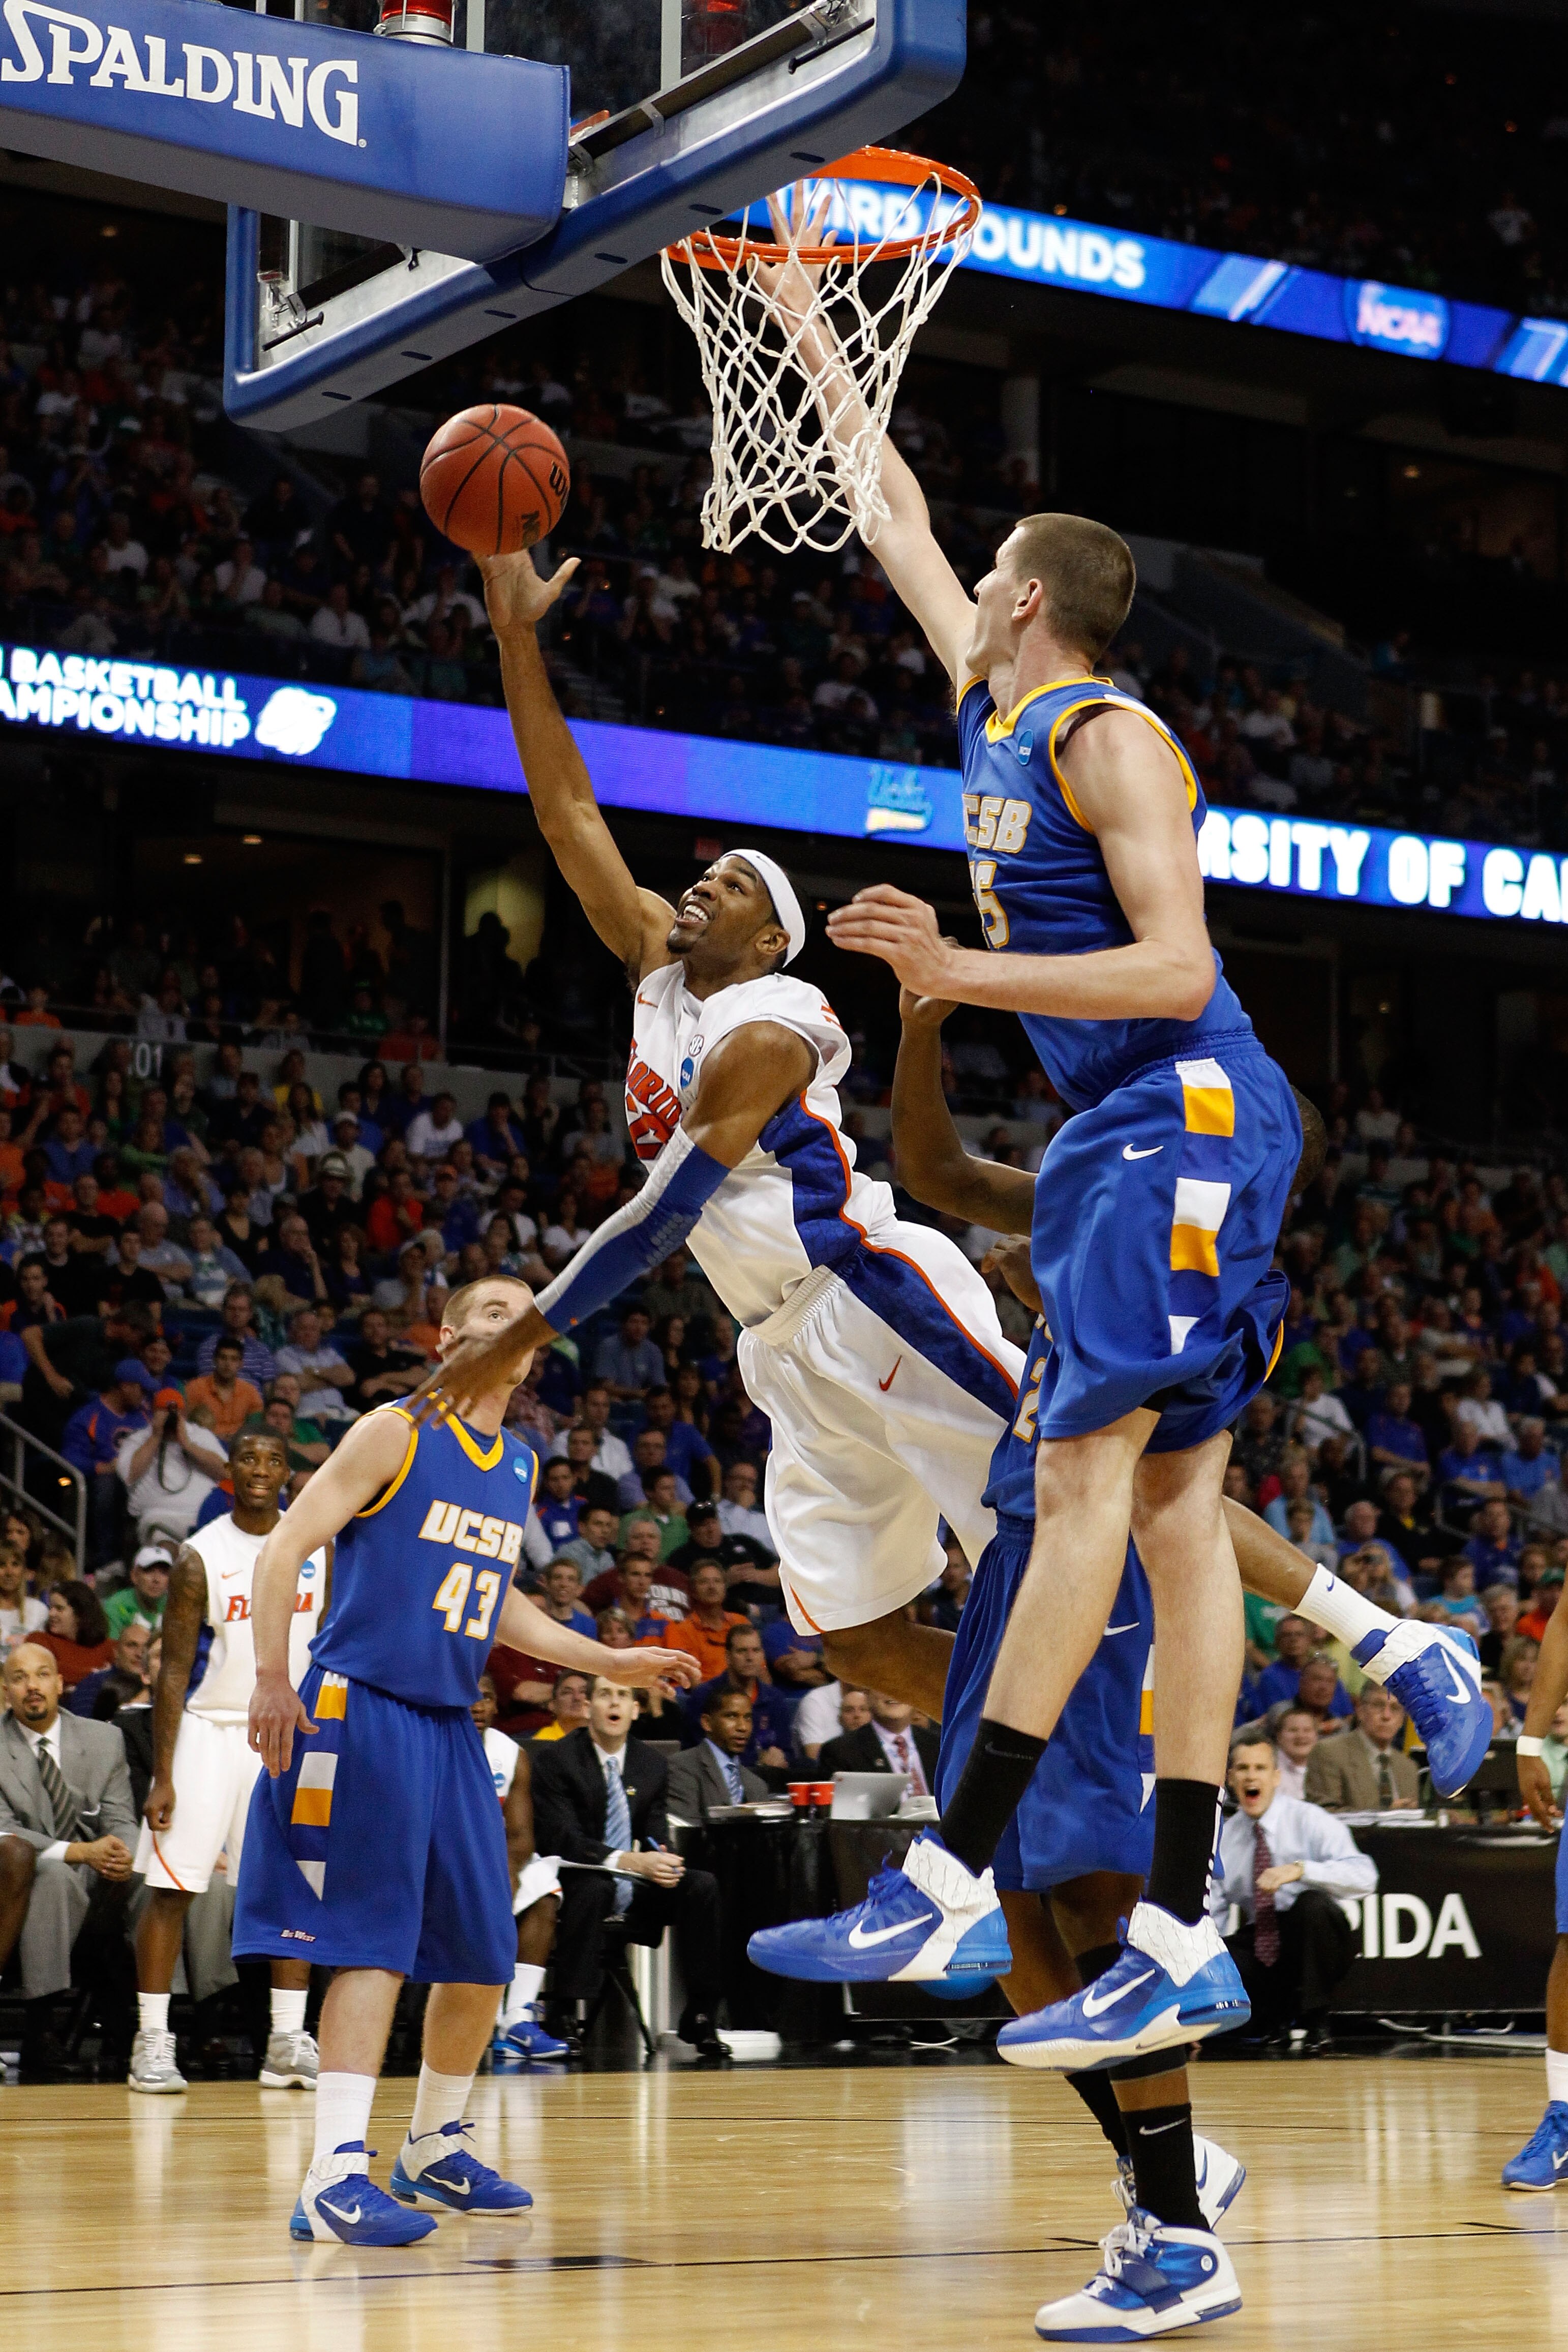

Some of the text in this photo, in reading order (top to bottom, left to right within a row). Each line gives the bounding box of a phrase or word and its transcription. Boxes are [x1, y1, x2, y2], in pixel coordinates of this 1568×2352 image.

[1, 0, 358, 146] SPALDING
[10, 646, 248, 712] BASKETBALL
[1388, 835, 1466, 909] OF
[418, 1498, 524, 1564] UCSB
[432, 1561, 502, 1641] 43
